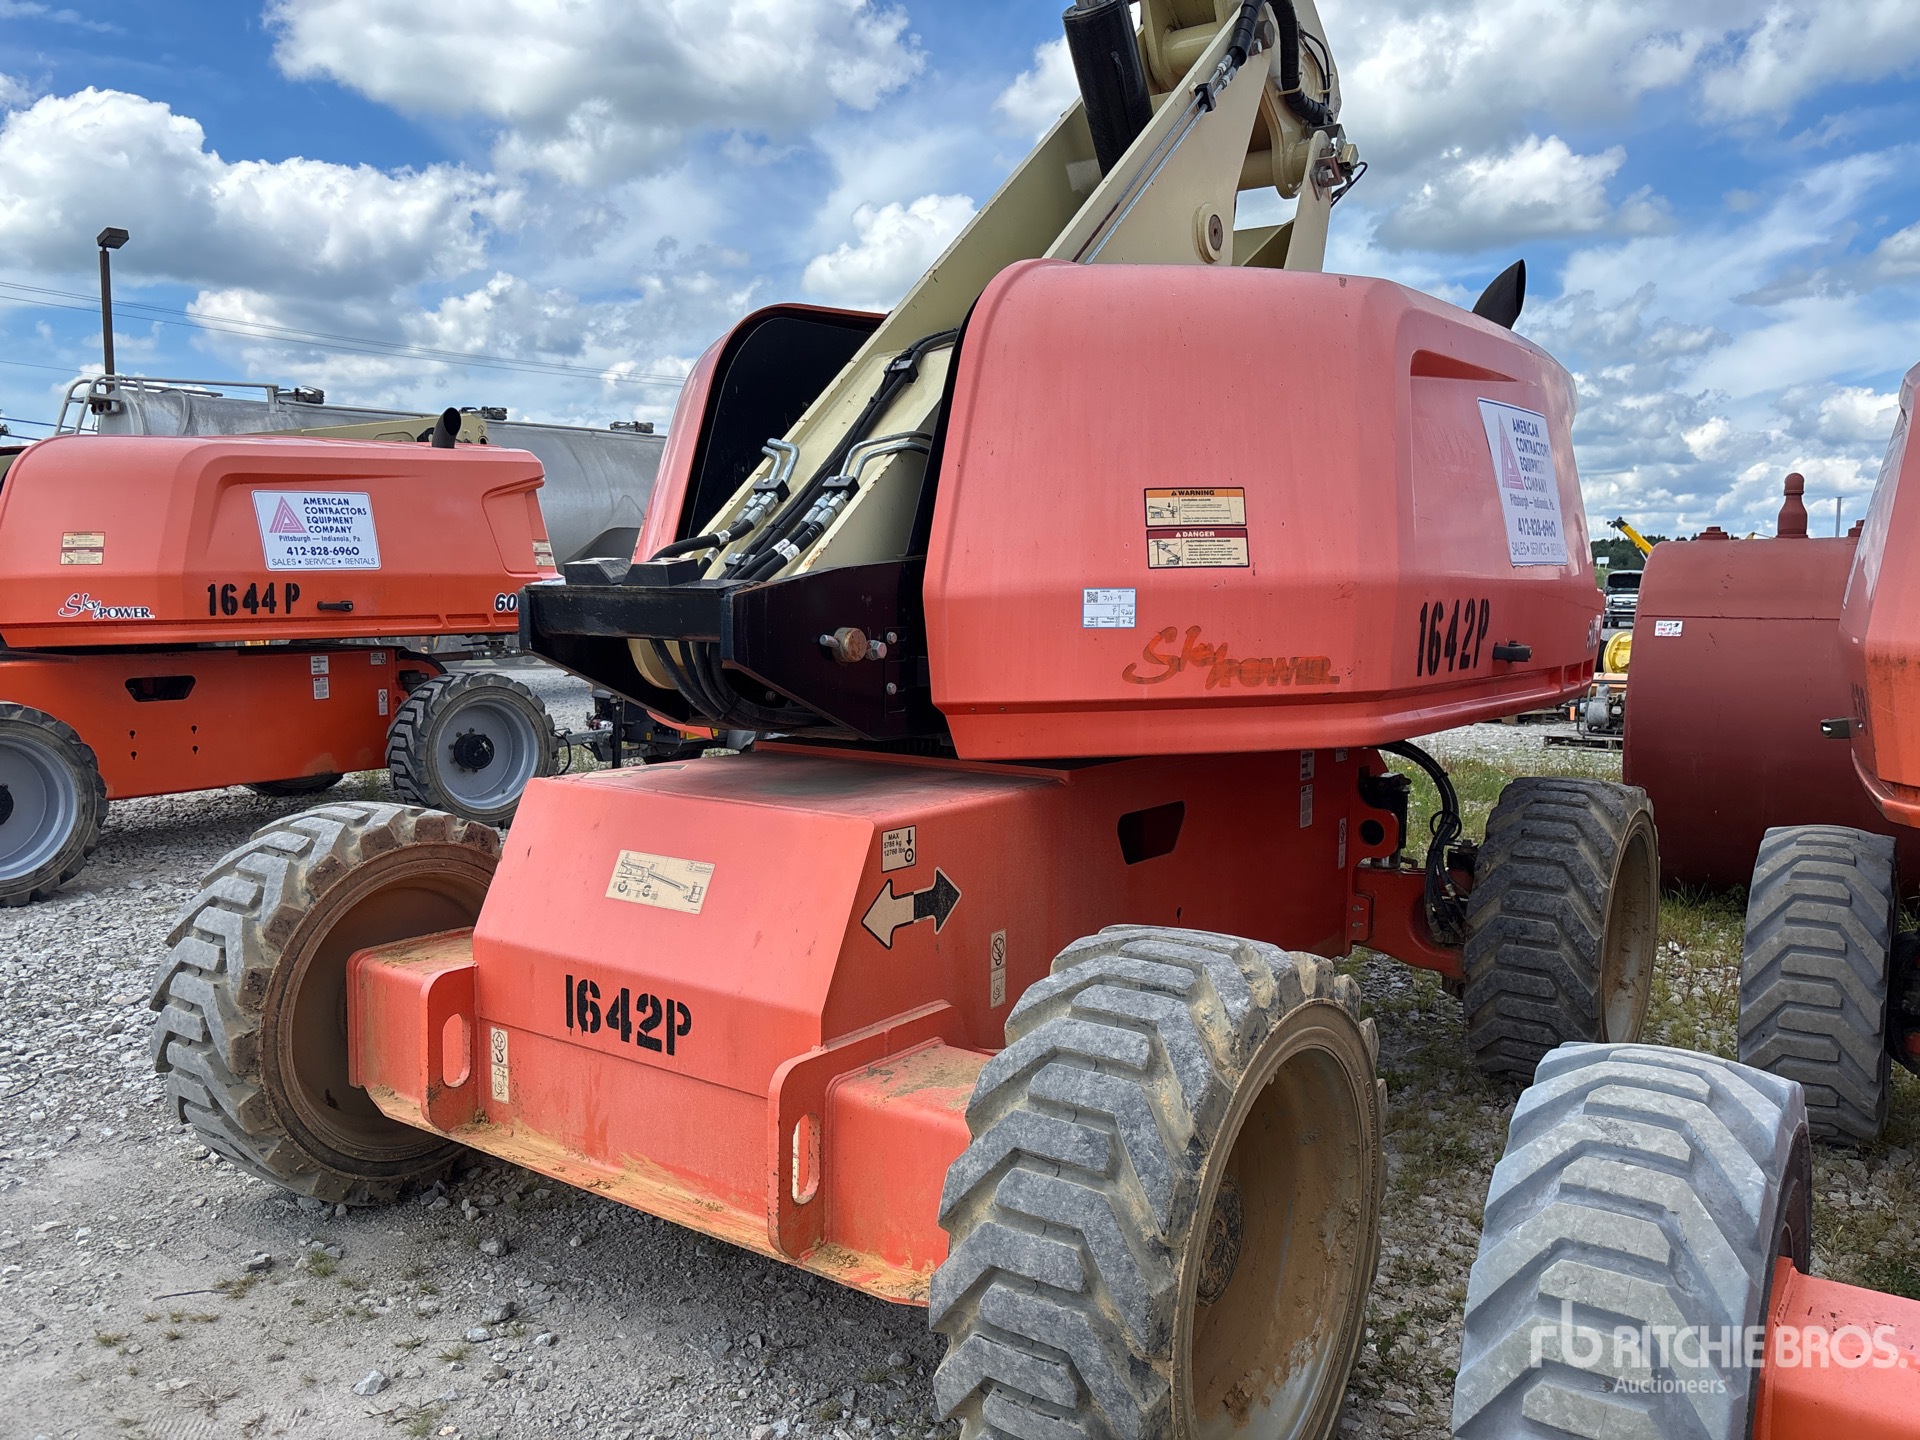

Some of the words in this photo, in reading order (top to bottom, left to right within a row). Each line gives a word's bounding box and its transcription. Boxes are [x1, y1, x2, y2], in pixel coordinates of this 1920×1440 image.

[1512, 418, 1540, 438] AMERICAN
[1523, 475, 1548, 493] COMPANY
[303, 497, 350, 506] AMERICAN
[304, 507, 367, 516] CONTRACTORS
[306, 516, 354, 525] EQUIPMENT
[308, 525, 352, 534] COMPANY
[278, 535, 312, 543] Pittsburgh
[286, 546, 360, 556] 412-828-6960
[1511, 541, 1528, 556] SALES
[272, 558, 297, 566] SALES
[304, 558, 337, 566] SERVICE
[344, 557, 376, 566] RENTALS
[207, 582, 277, 617] 1644
[285, 582, 301, 615] P
[1416, 598, 1491, 677] 1642P
[565, 974, 693, 1057] 1642P
